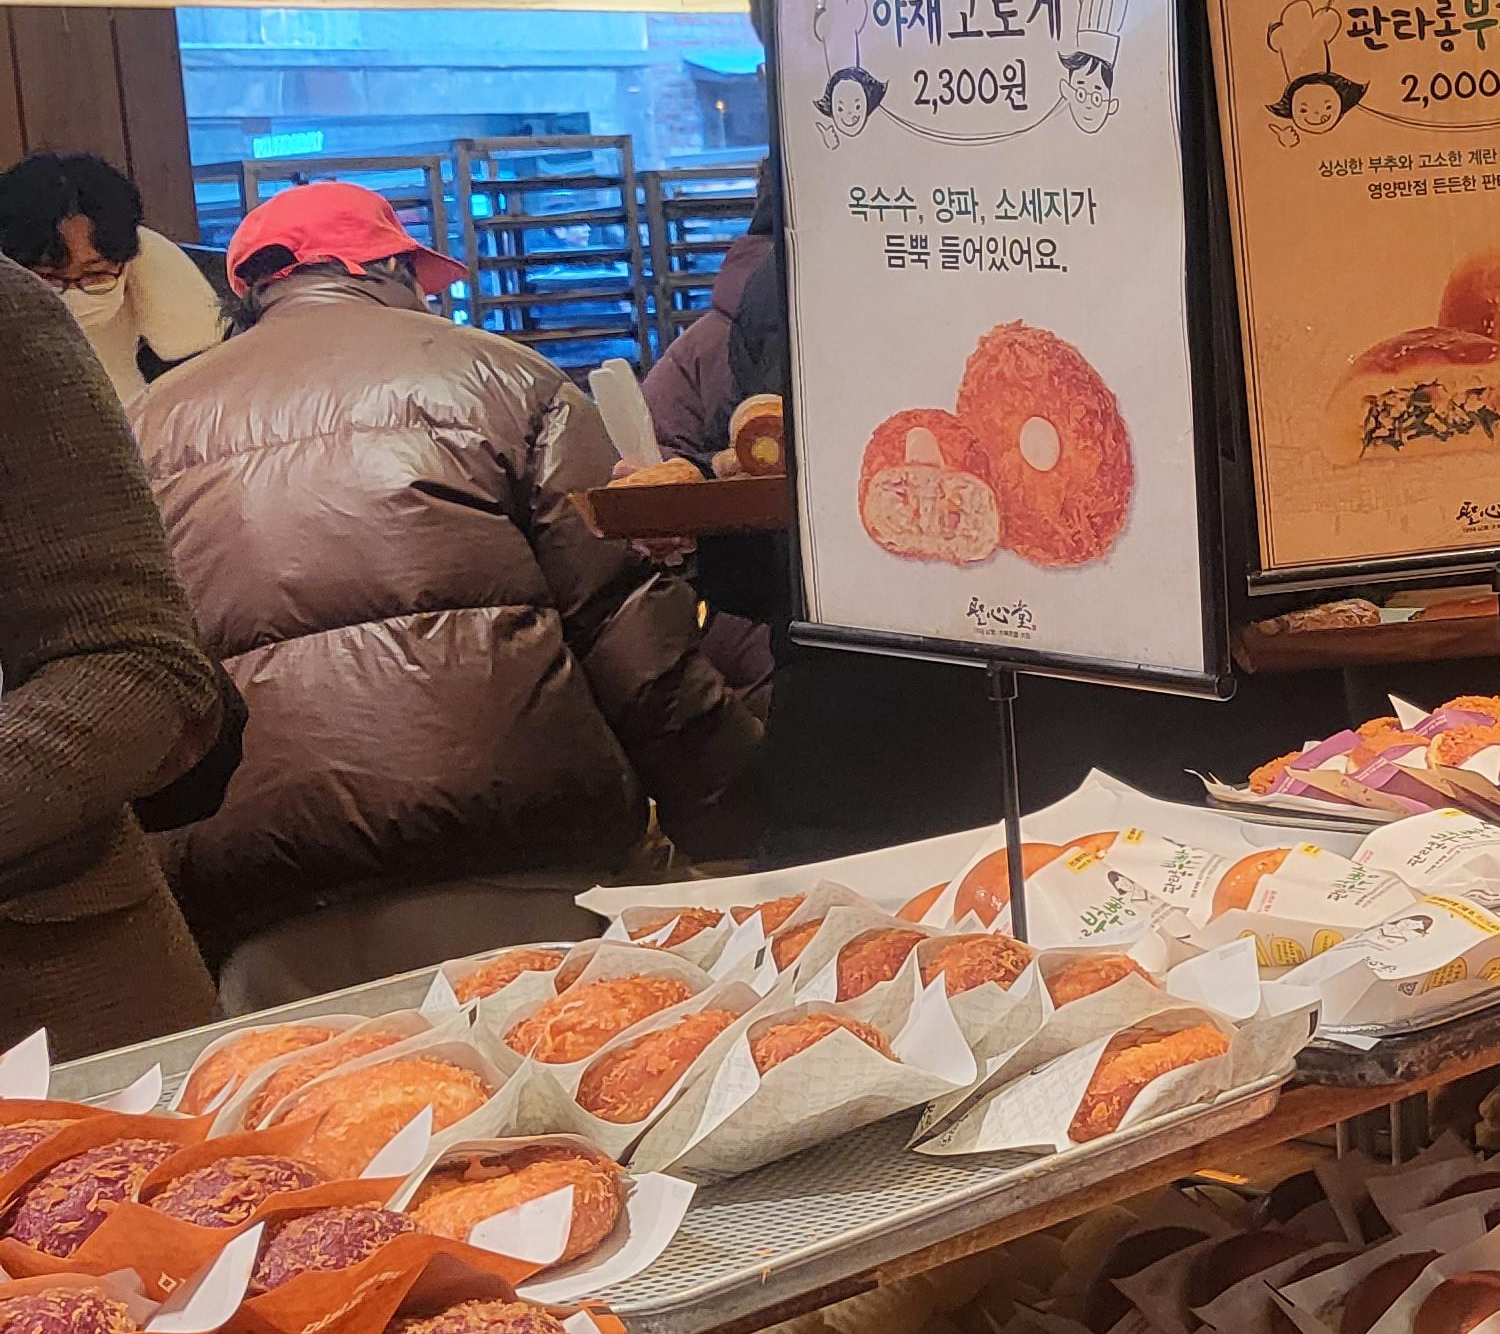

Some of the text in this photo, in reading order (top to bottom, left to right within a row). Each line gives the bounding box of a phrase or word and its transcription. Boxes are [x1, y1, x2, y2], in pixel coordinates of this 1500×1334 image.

[913, 59, 1029, 116] 2,300원
[1318, 157, 1363, 178] 싱싱한
[1368, 154, 1414, 175] 부추와
[1418, 150, 1463, 169] 고소한
[1468, 147, 1498, 165] 계란
[848, 186, 1097, 225] 옥수수, 양파, 소세지가
[1367, 179, 1428, 199] 영양만점
[1432, 175, 1477, 194] 든든한
[884, 234, 1068, 273] 듬뿍 들어있어요.
